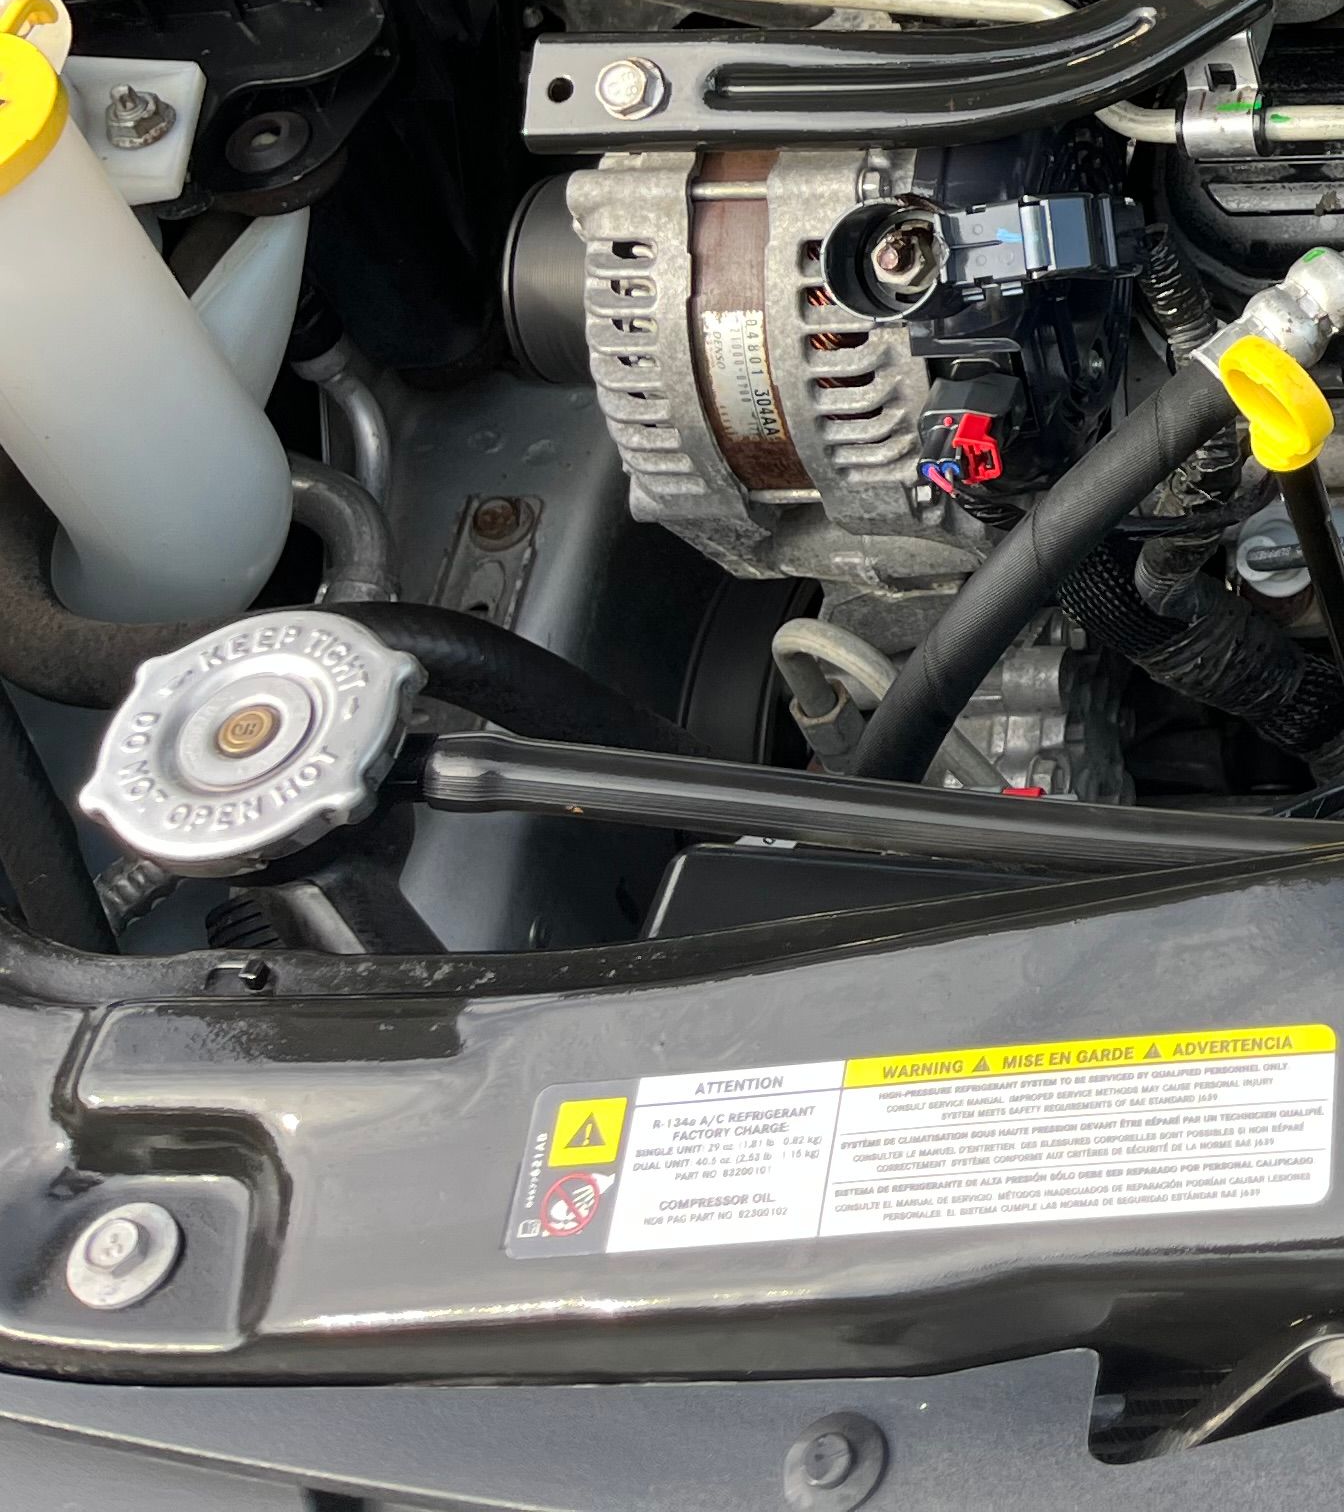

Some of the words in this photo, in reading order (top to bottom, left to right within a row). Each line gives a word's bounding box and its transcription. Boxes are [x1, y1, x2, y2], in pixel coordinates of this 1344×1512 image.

[712, 331, 726, 370] DENSO
[745, 319, 764, 375] 04801
[754, 389, 780, 437] 304AA
[199, 625, 301, 672] KEEP
[304, 629, 368, 692] TIGHT
[163, 800, 264, 833] OPEN
[270, 745, 339, 807] HOT
[882, 1060, 964, 1080] WARNING
[1002, 1052, 1044, 1069] MISE
[1048, 1051, 1071, 1065] EN
[1076, 1047, 1134, 1064] GARDE
[1172, 1036, 1293, 1057] ADVERTENCIA
[695, 1076, 784, 1096] ATTENTION
[672, 1127, 731, 1141] FACTORY
[734, 1122, 790, 1136] CHARGE
[699, 1114, 725, 1127] A/C
[728, 1105, 816, 1123] REFRIGERANT
[675, 1171, 699, 1180] PART
[659, 1193, 750, 1211] COMPRESSOR
[752, 1192, 776, 1204] OIL
